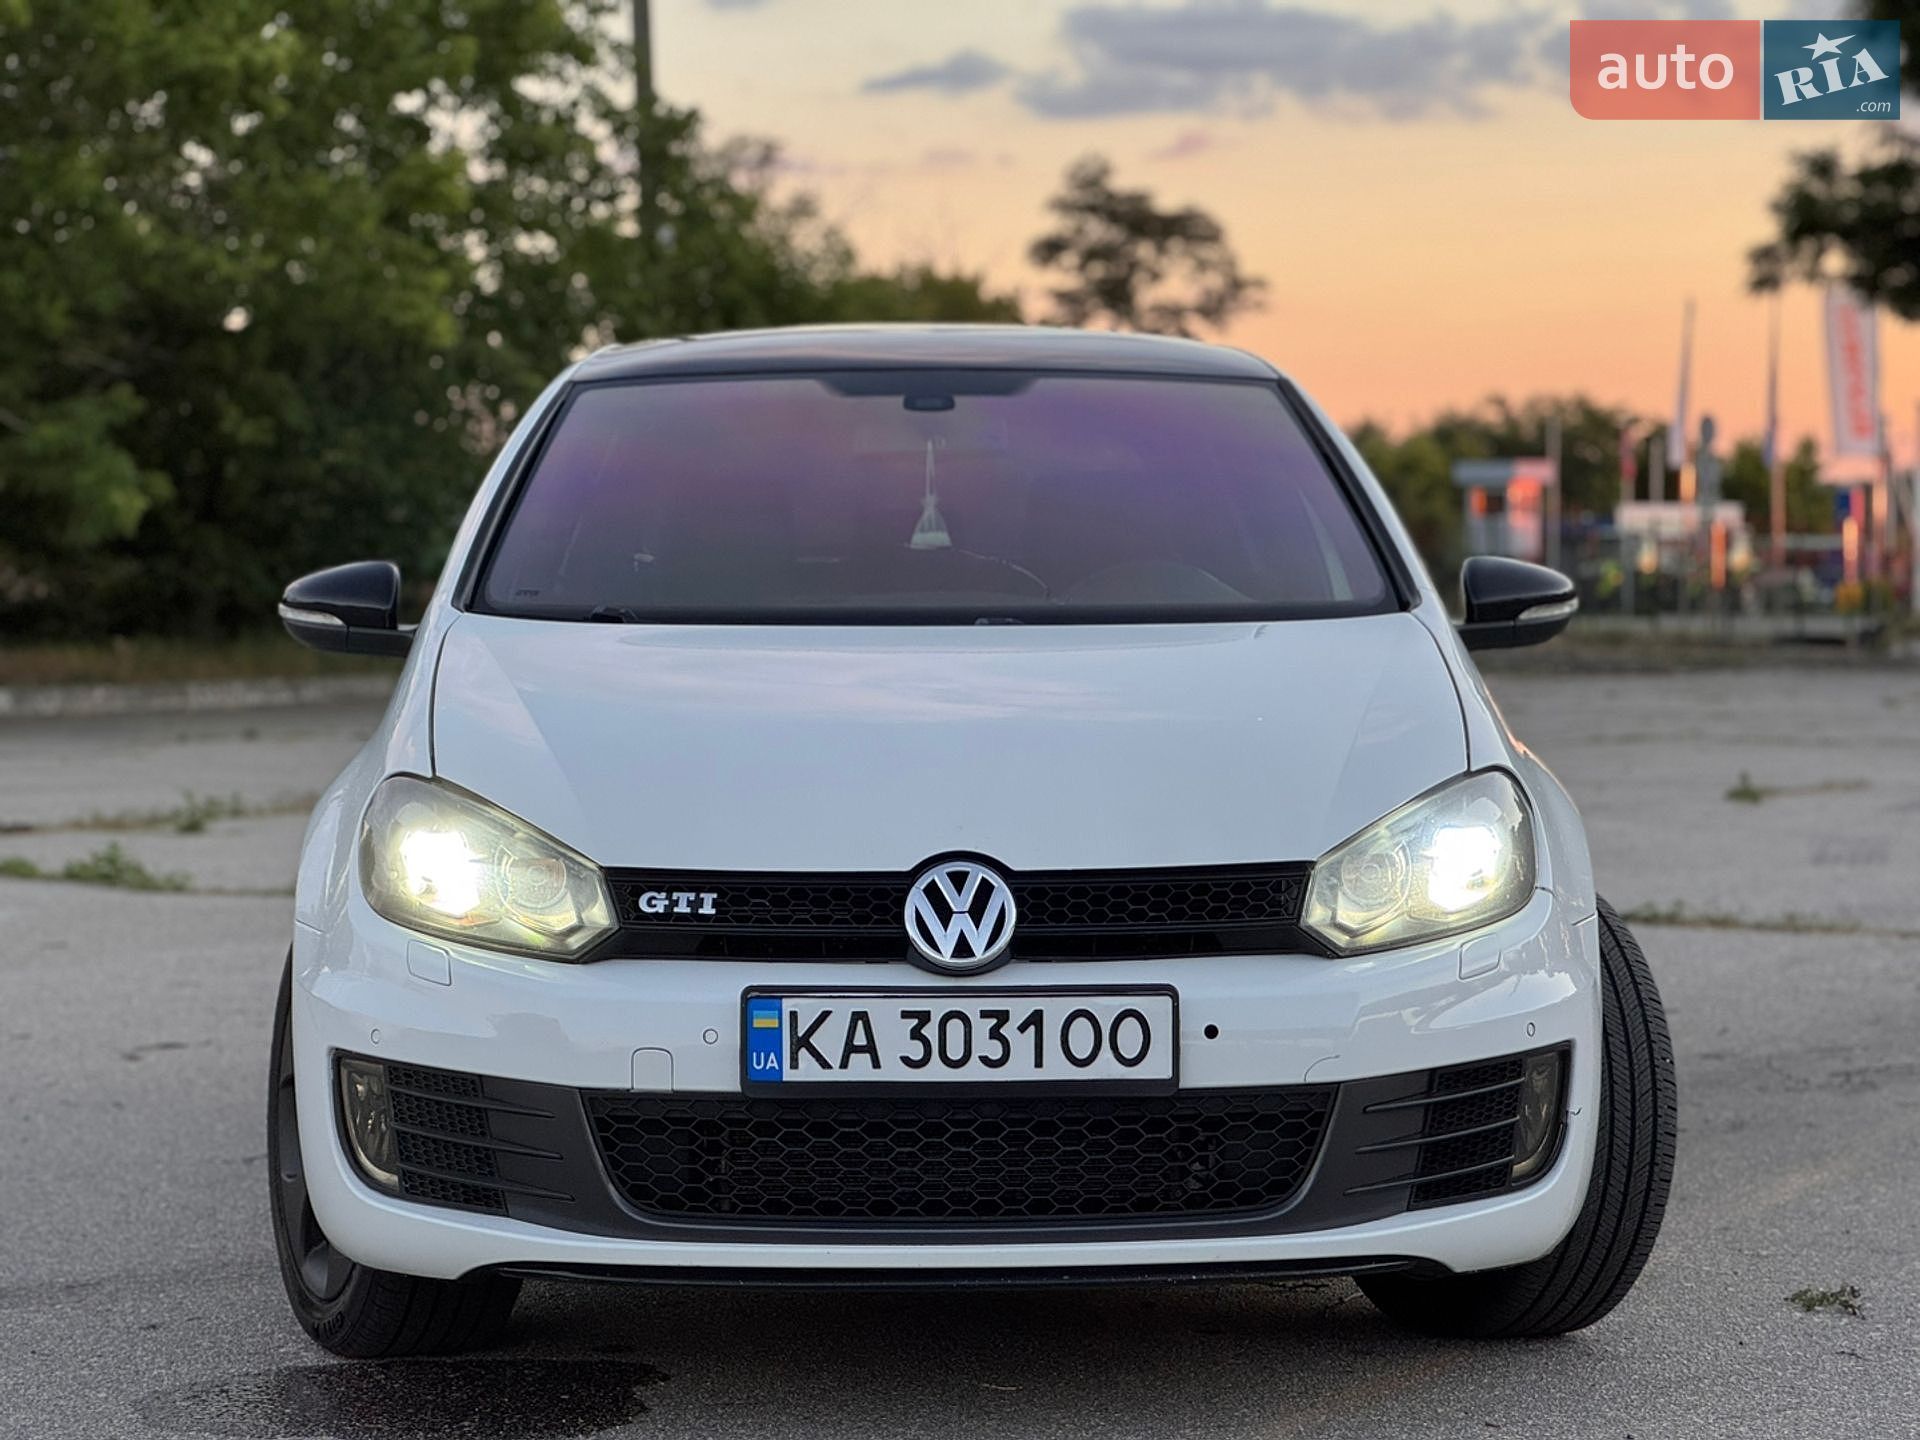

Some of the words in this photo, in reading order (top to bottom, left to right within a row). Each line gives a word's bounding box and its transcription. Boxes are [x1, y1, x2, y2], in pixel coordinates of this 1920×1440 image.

[638, 891, 718, 915] GTI
[789, 1009, 882, 1070] KA
[753, 1052, 779, 1070] UA
